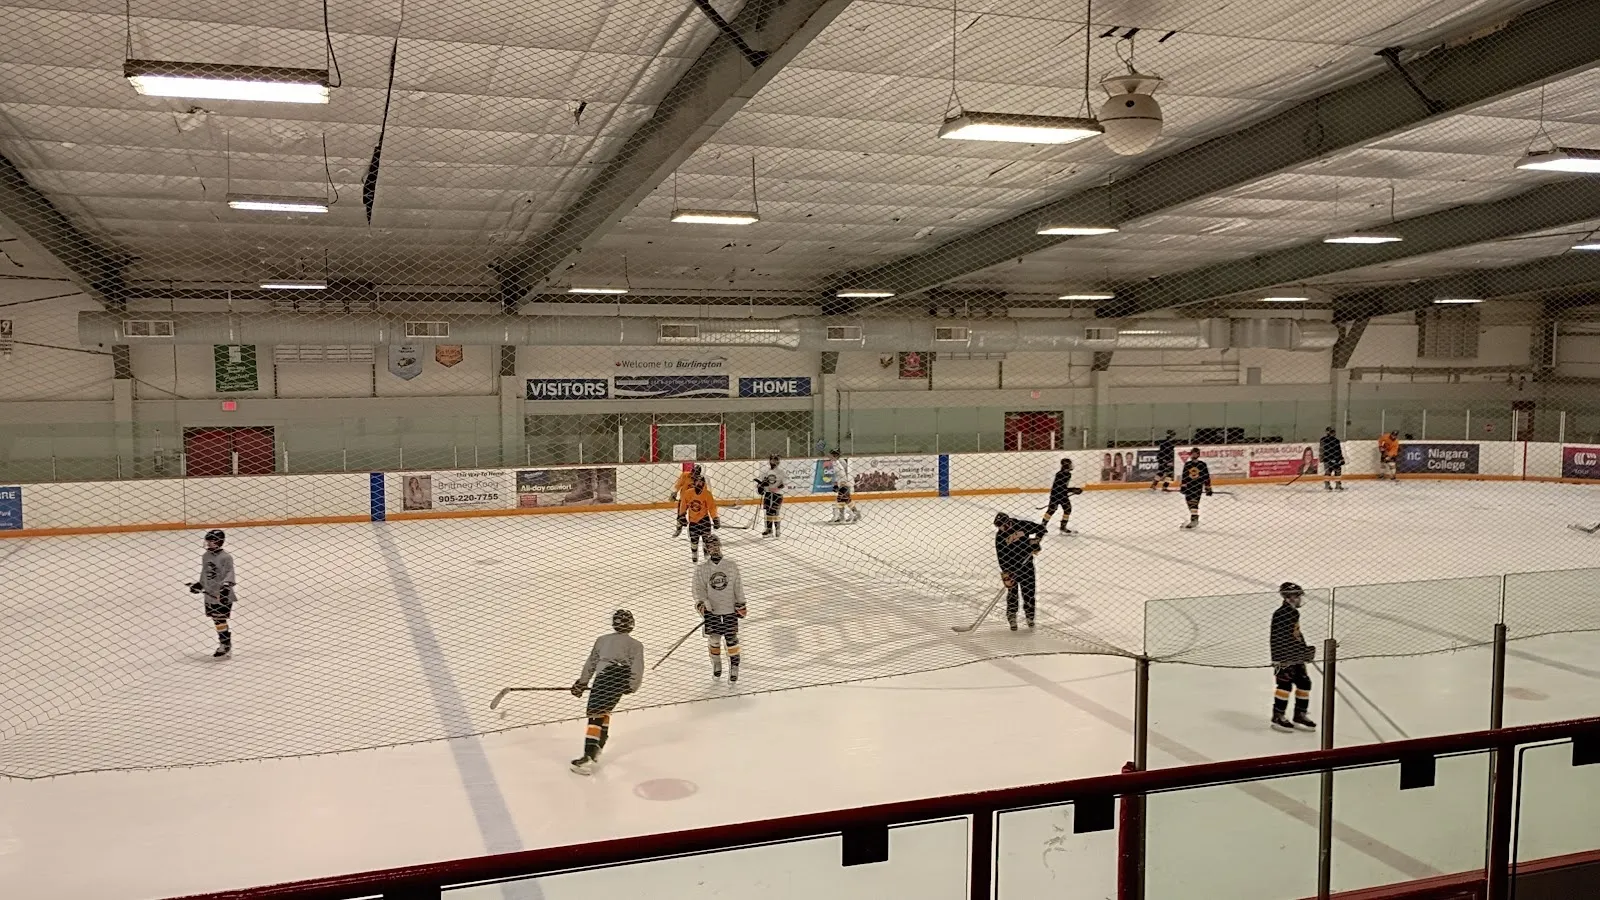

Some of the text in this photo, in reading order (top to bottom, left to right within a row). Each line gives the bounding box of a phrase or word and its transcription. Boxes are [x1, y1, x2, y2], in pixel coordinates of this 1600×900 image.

[621, 360, 722, 370] Welcome to Burlington
[530, 381, 605, 397] VISITORS
[752, 380, 797, 394] HOME
[1406, 450, 1421, 461] nc
[1428, 448, 1469, 460] Niagara
[1427, 460, 1466, 471] College
[438, 493, 499, 503] 905-220-7755
